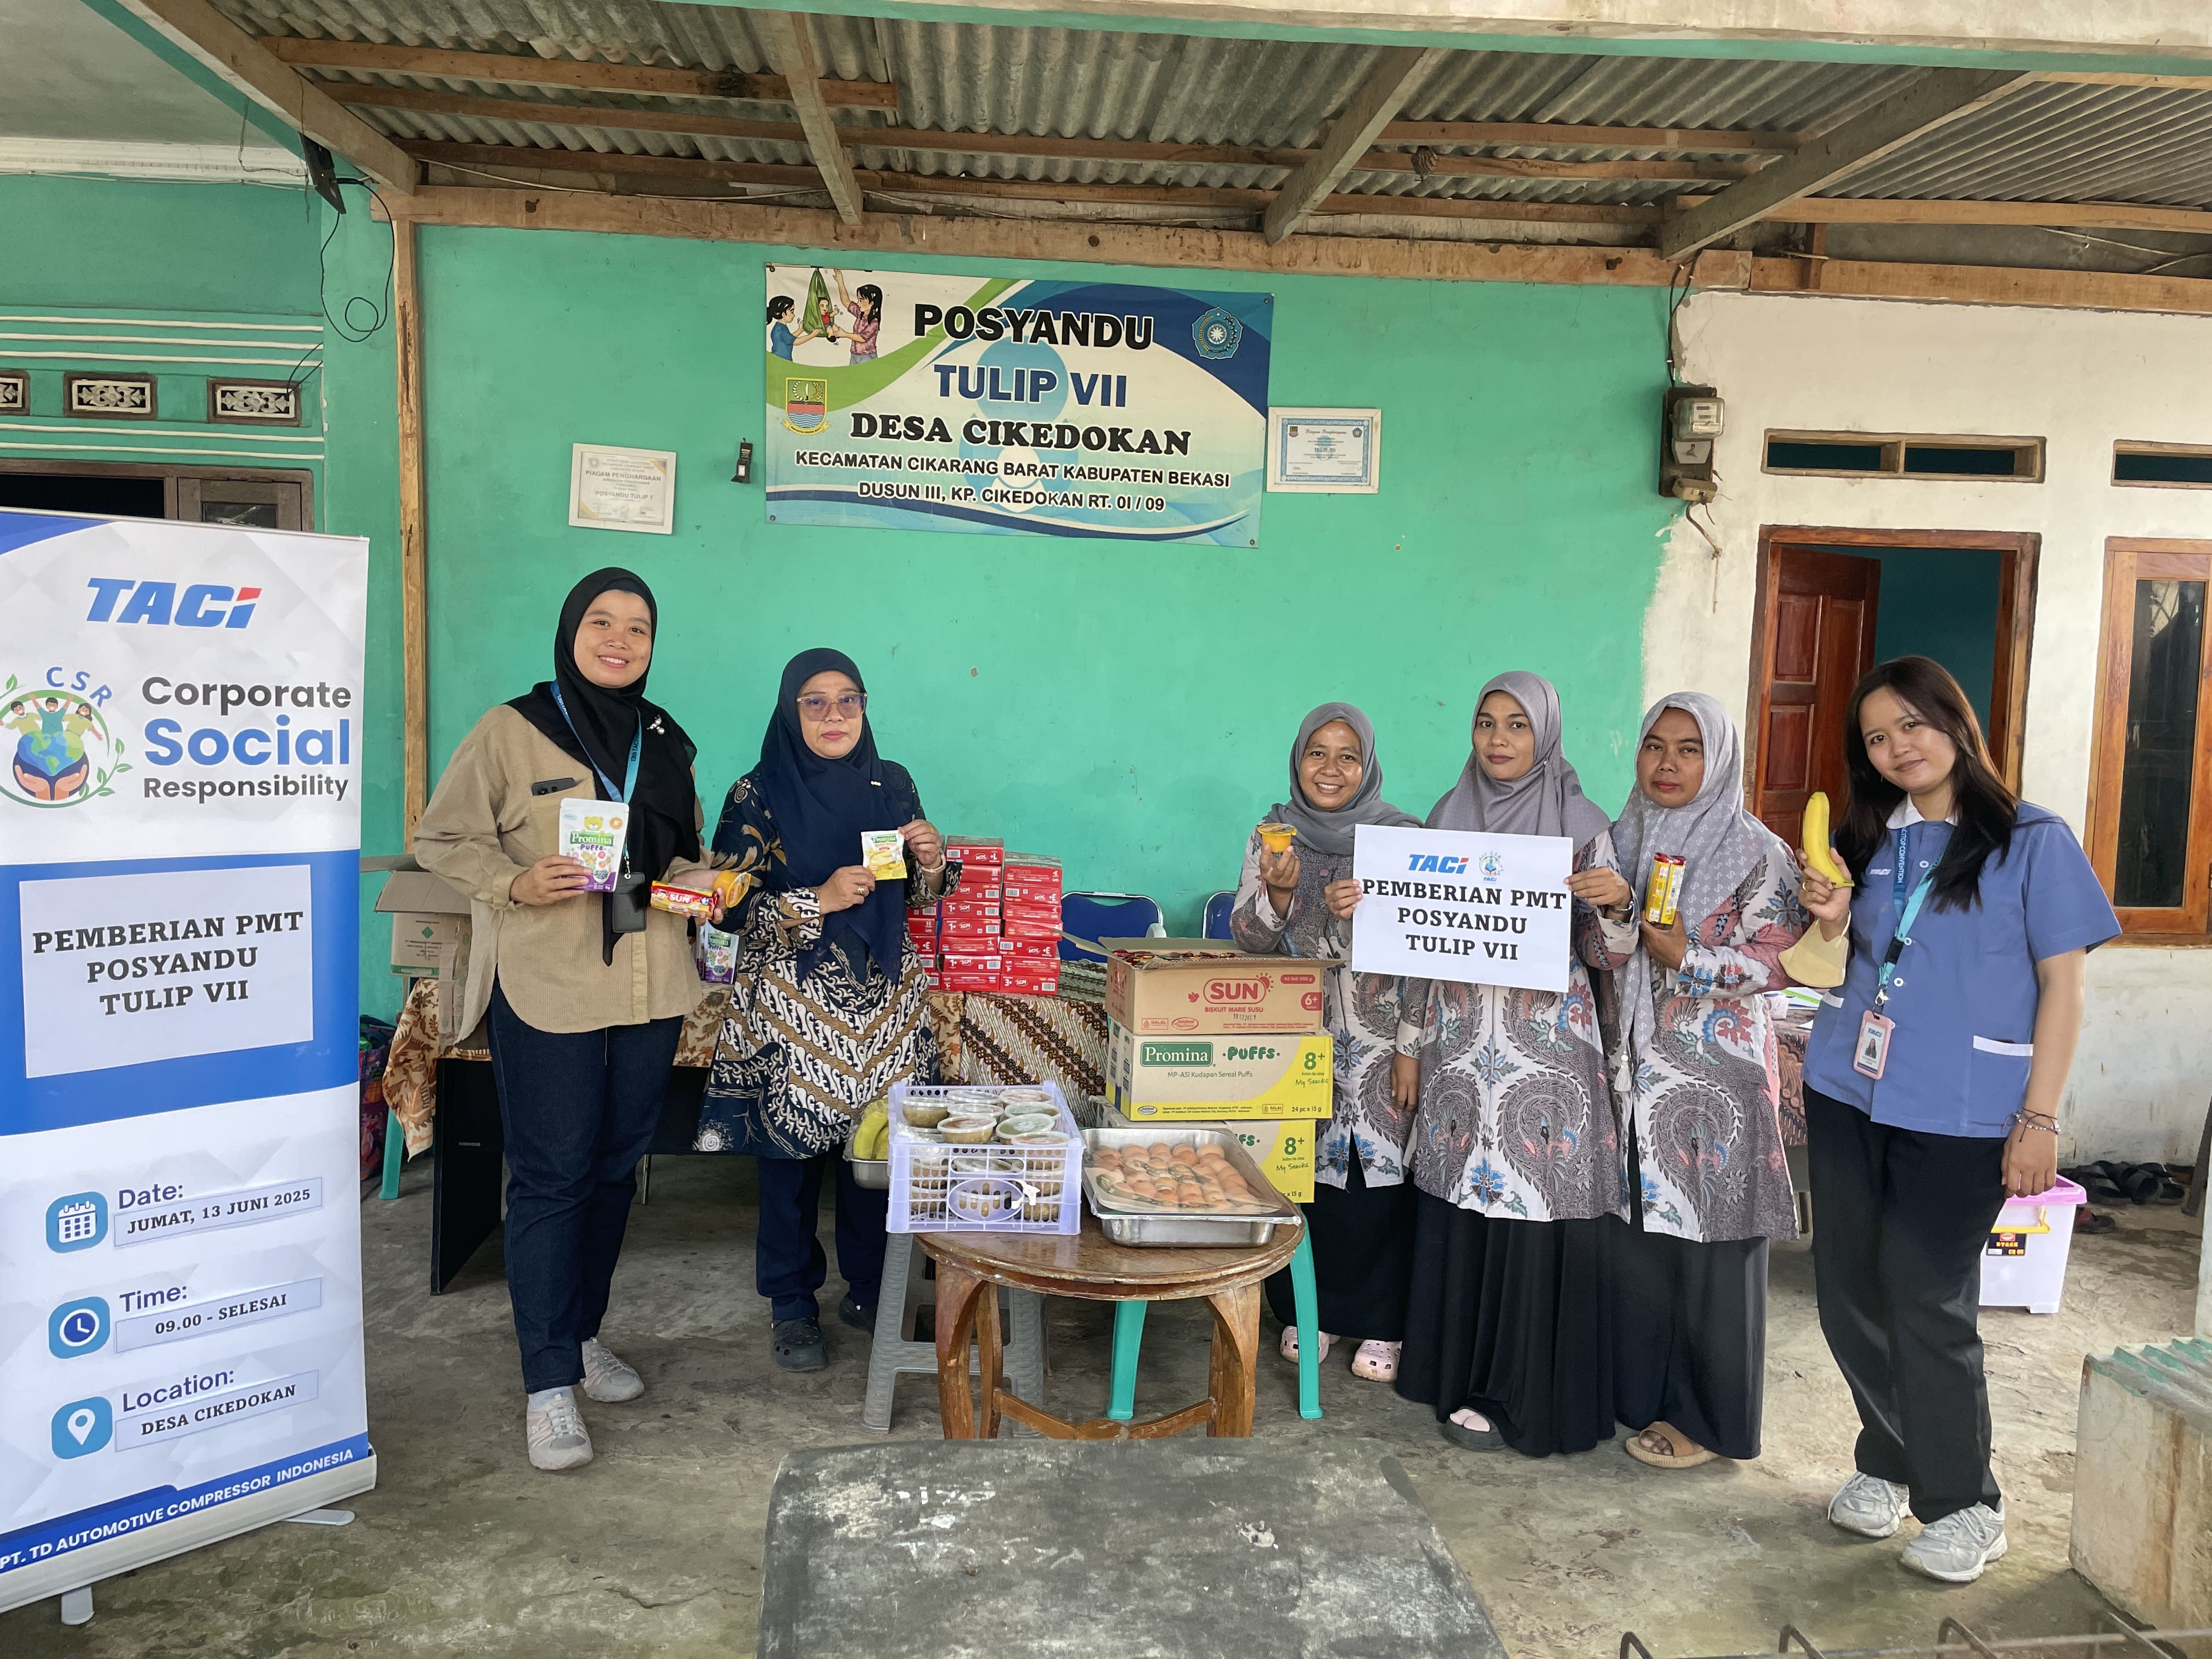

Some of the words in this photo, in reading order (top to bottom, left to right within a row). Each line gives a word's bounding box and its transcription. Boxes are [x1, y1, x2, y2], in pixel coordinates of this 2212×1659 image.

[915, 304, 1153, 350] POSYANDU
[934, 364, 1057, 403] TULIP
[1069, 373, 1127, 408] VII
[851, 413, 952, 443] DESA
[962, 419, 1192, 456] CIKEDOKAN
[612, 473, 661, 481] PENGHARGAAN
[795, 451, 902, 471] KECAMATAN
[907, 455, 998, 475] CIKARANG
[1003, 461, 1059, 478] BARAT
[1063, 465, 1164, 485] KABUPATEN
[1169, 471, 1229, 488] BEKASI
[859, 482, 920, 499] DUSUN
[924, 486, 947, 503] III,
[951, 486, 977, 502] KP.
[981, 488, 1083, 509] CIKEDOKAN
[1088, 493, 1113, 509] RT.
[1144, 496, 1164, 512] 09
[46, 666, 113, 708] CSR
[142, 676, 351, 716] Corporate
[144, 714, 350, 765] Social
[144, 775, 348, 804] Responsibility
[572, 833, 612, 844] Promina
[669, 894, 691, 903] SUN
[1362, 878, 1502, 906] PEMBERIAN
[1510, 890, 1566, 910] PMT
[33, 916, 225, 953] PEMBERIAN
[236, 911, 304, 935] PMT
[1397, 908, 1527, 934] POSYANDU
[1406, 934, 1475, 956] TULIP
[1483, 942, 1518, 960] VII
[87, 946, 258, 983] POSYANDU
[99, 985, 193, 1015] TULIP
[203, 980, 249, 1003] VII
[1210, 983, 1258, 1000] SUN
[1305, 995, 1318, 1005] 6+
[1145, 1047, 1209, 1062] Promina
[1304, 1052, 1325, 1070] 8+
[1295, 1079, 1305, 1088] My
[1284, 1137, 1305, 1155] 8+
[119, 1181, 184, 1210] Date:
[127, 1209, 196, 1234] JUMAT,
[202, 1204, 221, 1220] 13
[227, 1196, 269, 1217] JUNI
[274, 1188, 311, 1206] 2025
[120, 1284, 188, 1313] Time:
[155, 1313, 202, 1335] 09.00
[218, 1294, 287, 1321] SELESAI
[122, 1367, 235, 1412] Location:
[142, 1413, 189, 1436] DESA
[194, 1384, 297, 1423] CIKEDOKAN
[0, 1550, 26, 1570] PT.
[30, 1542, 52, 1560] TD
[55, 1506, 164, 1553] AUTOMOTIVE
[167, 1475, 271, 1516] COMPRESSOR
[276, 1448, 354, 1482] INDONESIA
